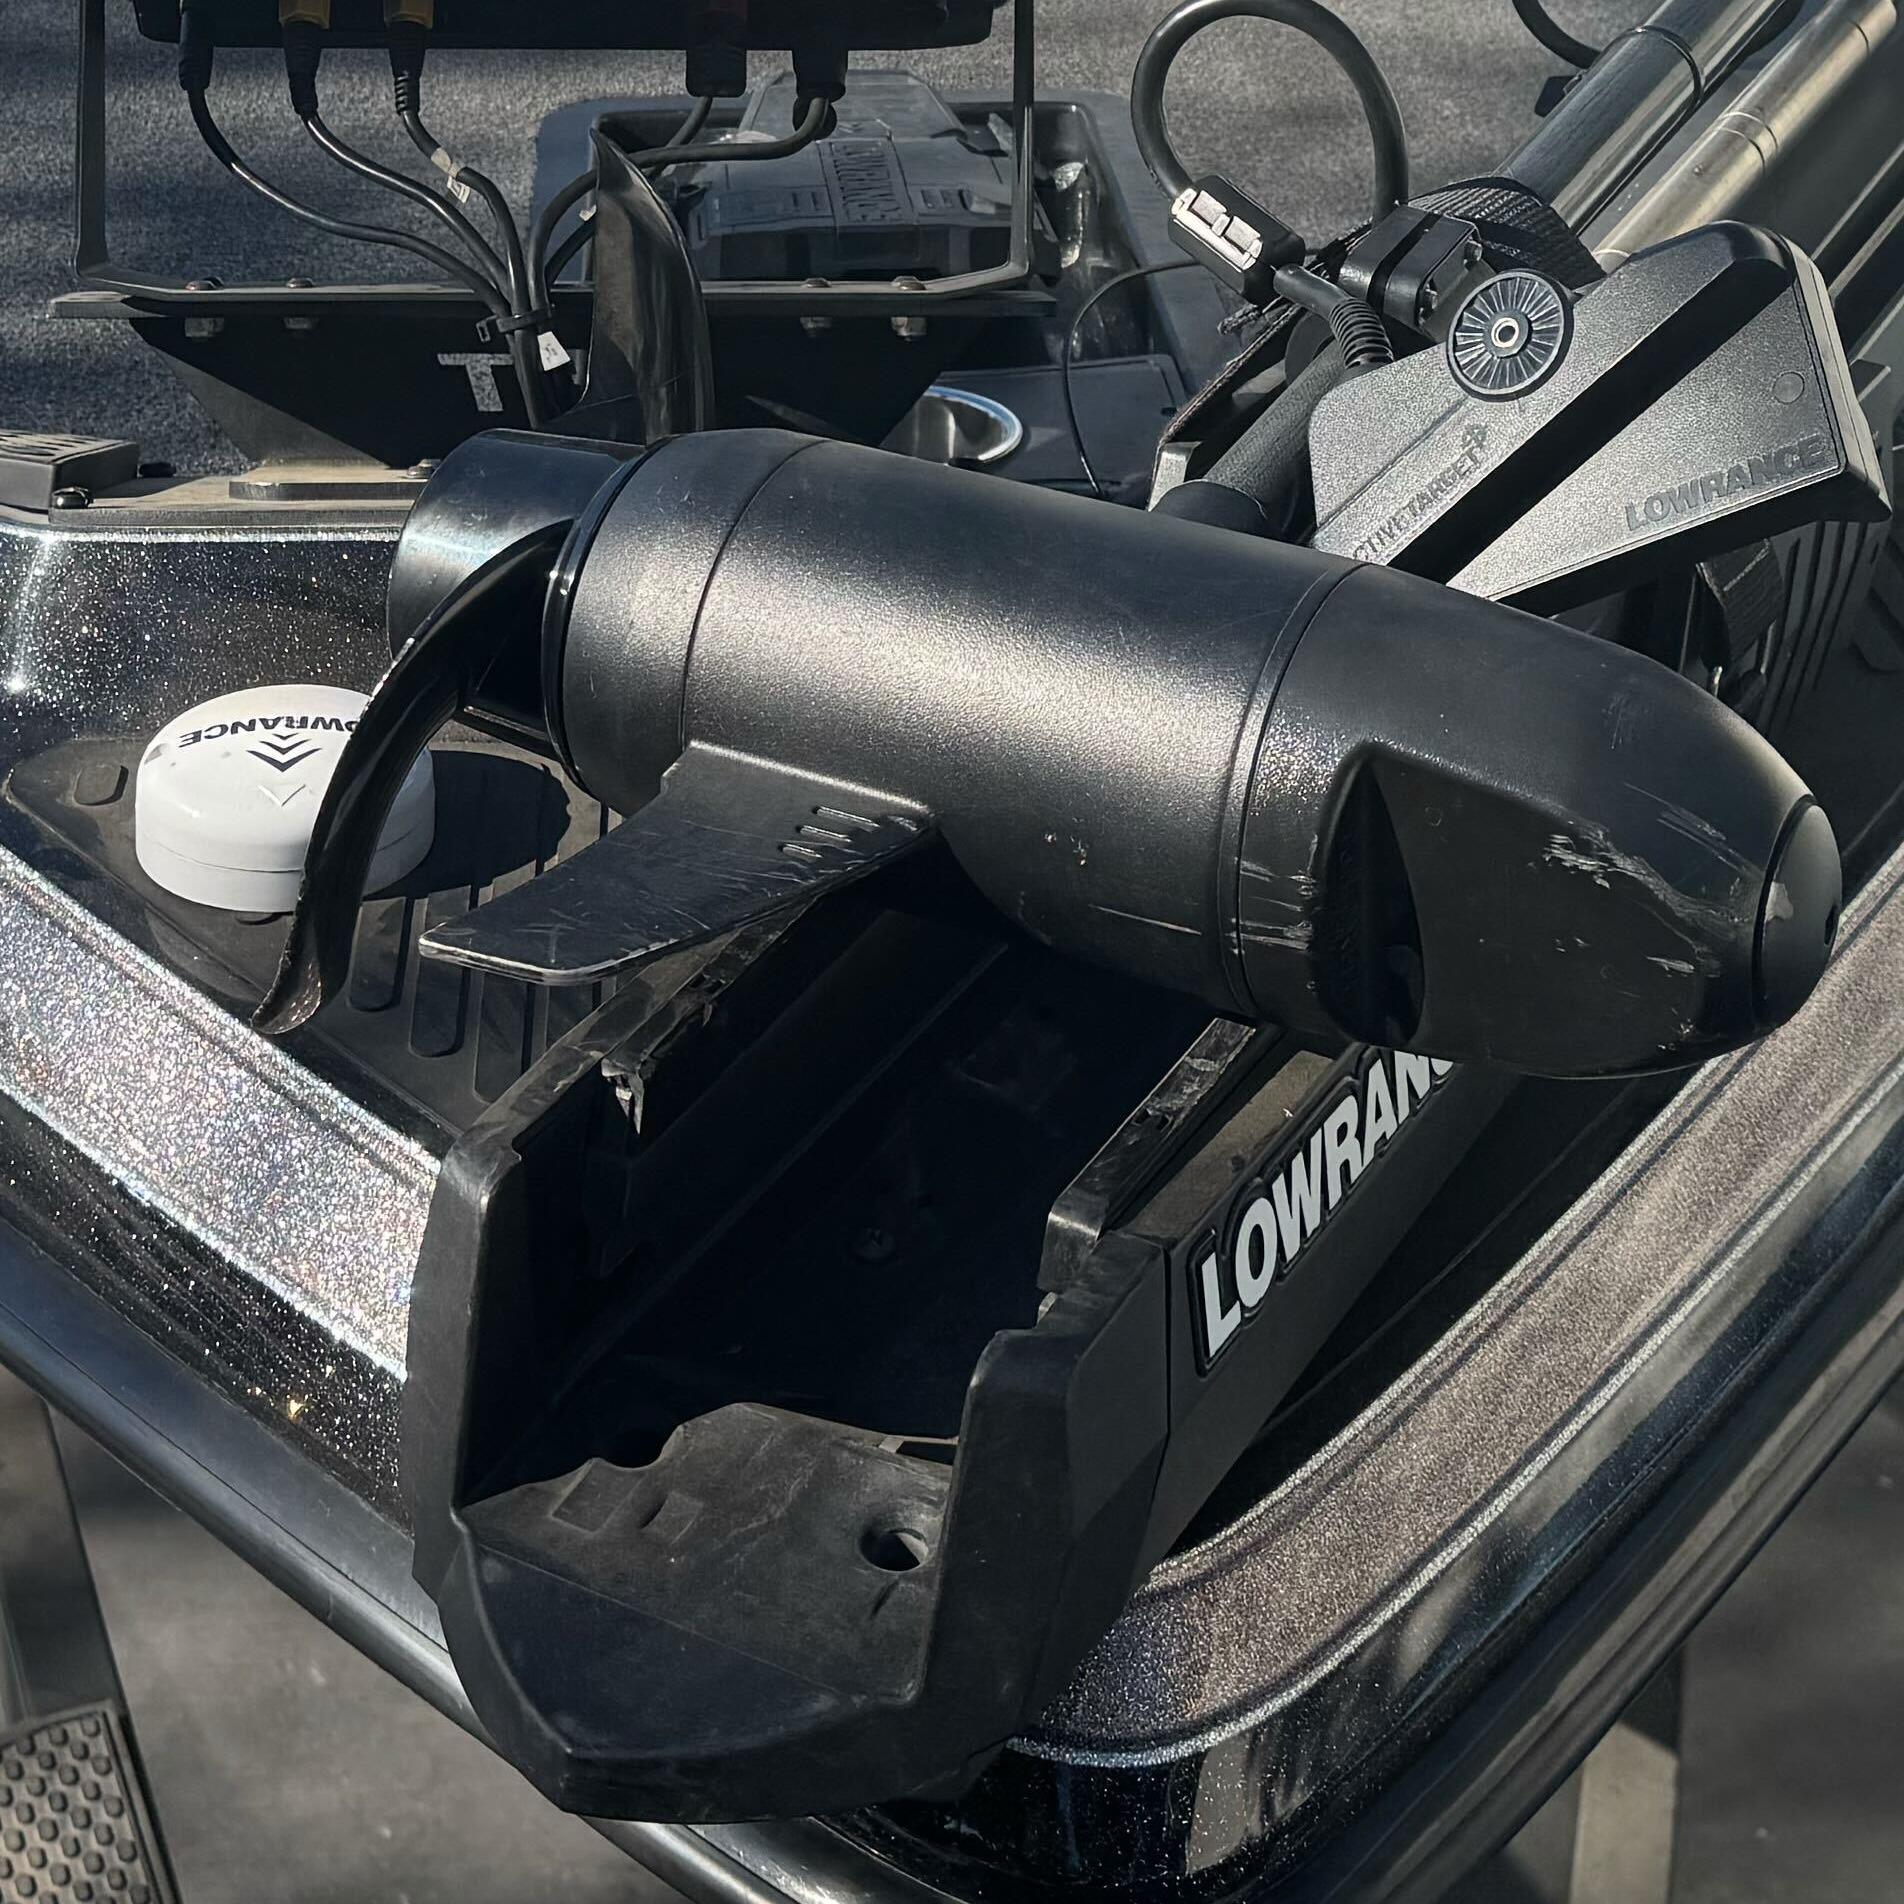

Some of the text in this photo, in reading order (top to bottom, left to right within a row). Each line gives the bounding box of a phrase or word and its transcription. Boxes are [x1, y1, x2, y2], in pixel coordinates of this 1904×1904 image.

[1352, 446, 1482, 560] CTIVETARGET
[1624, 432, 1831, 533] LOWRANCE
[168, 715, 358, 750] OWRANCE
[1200, 1049, 1456, 1358] LOWRAN
